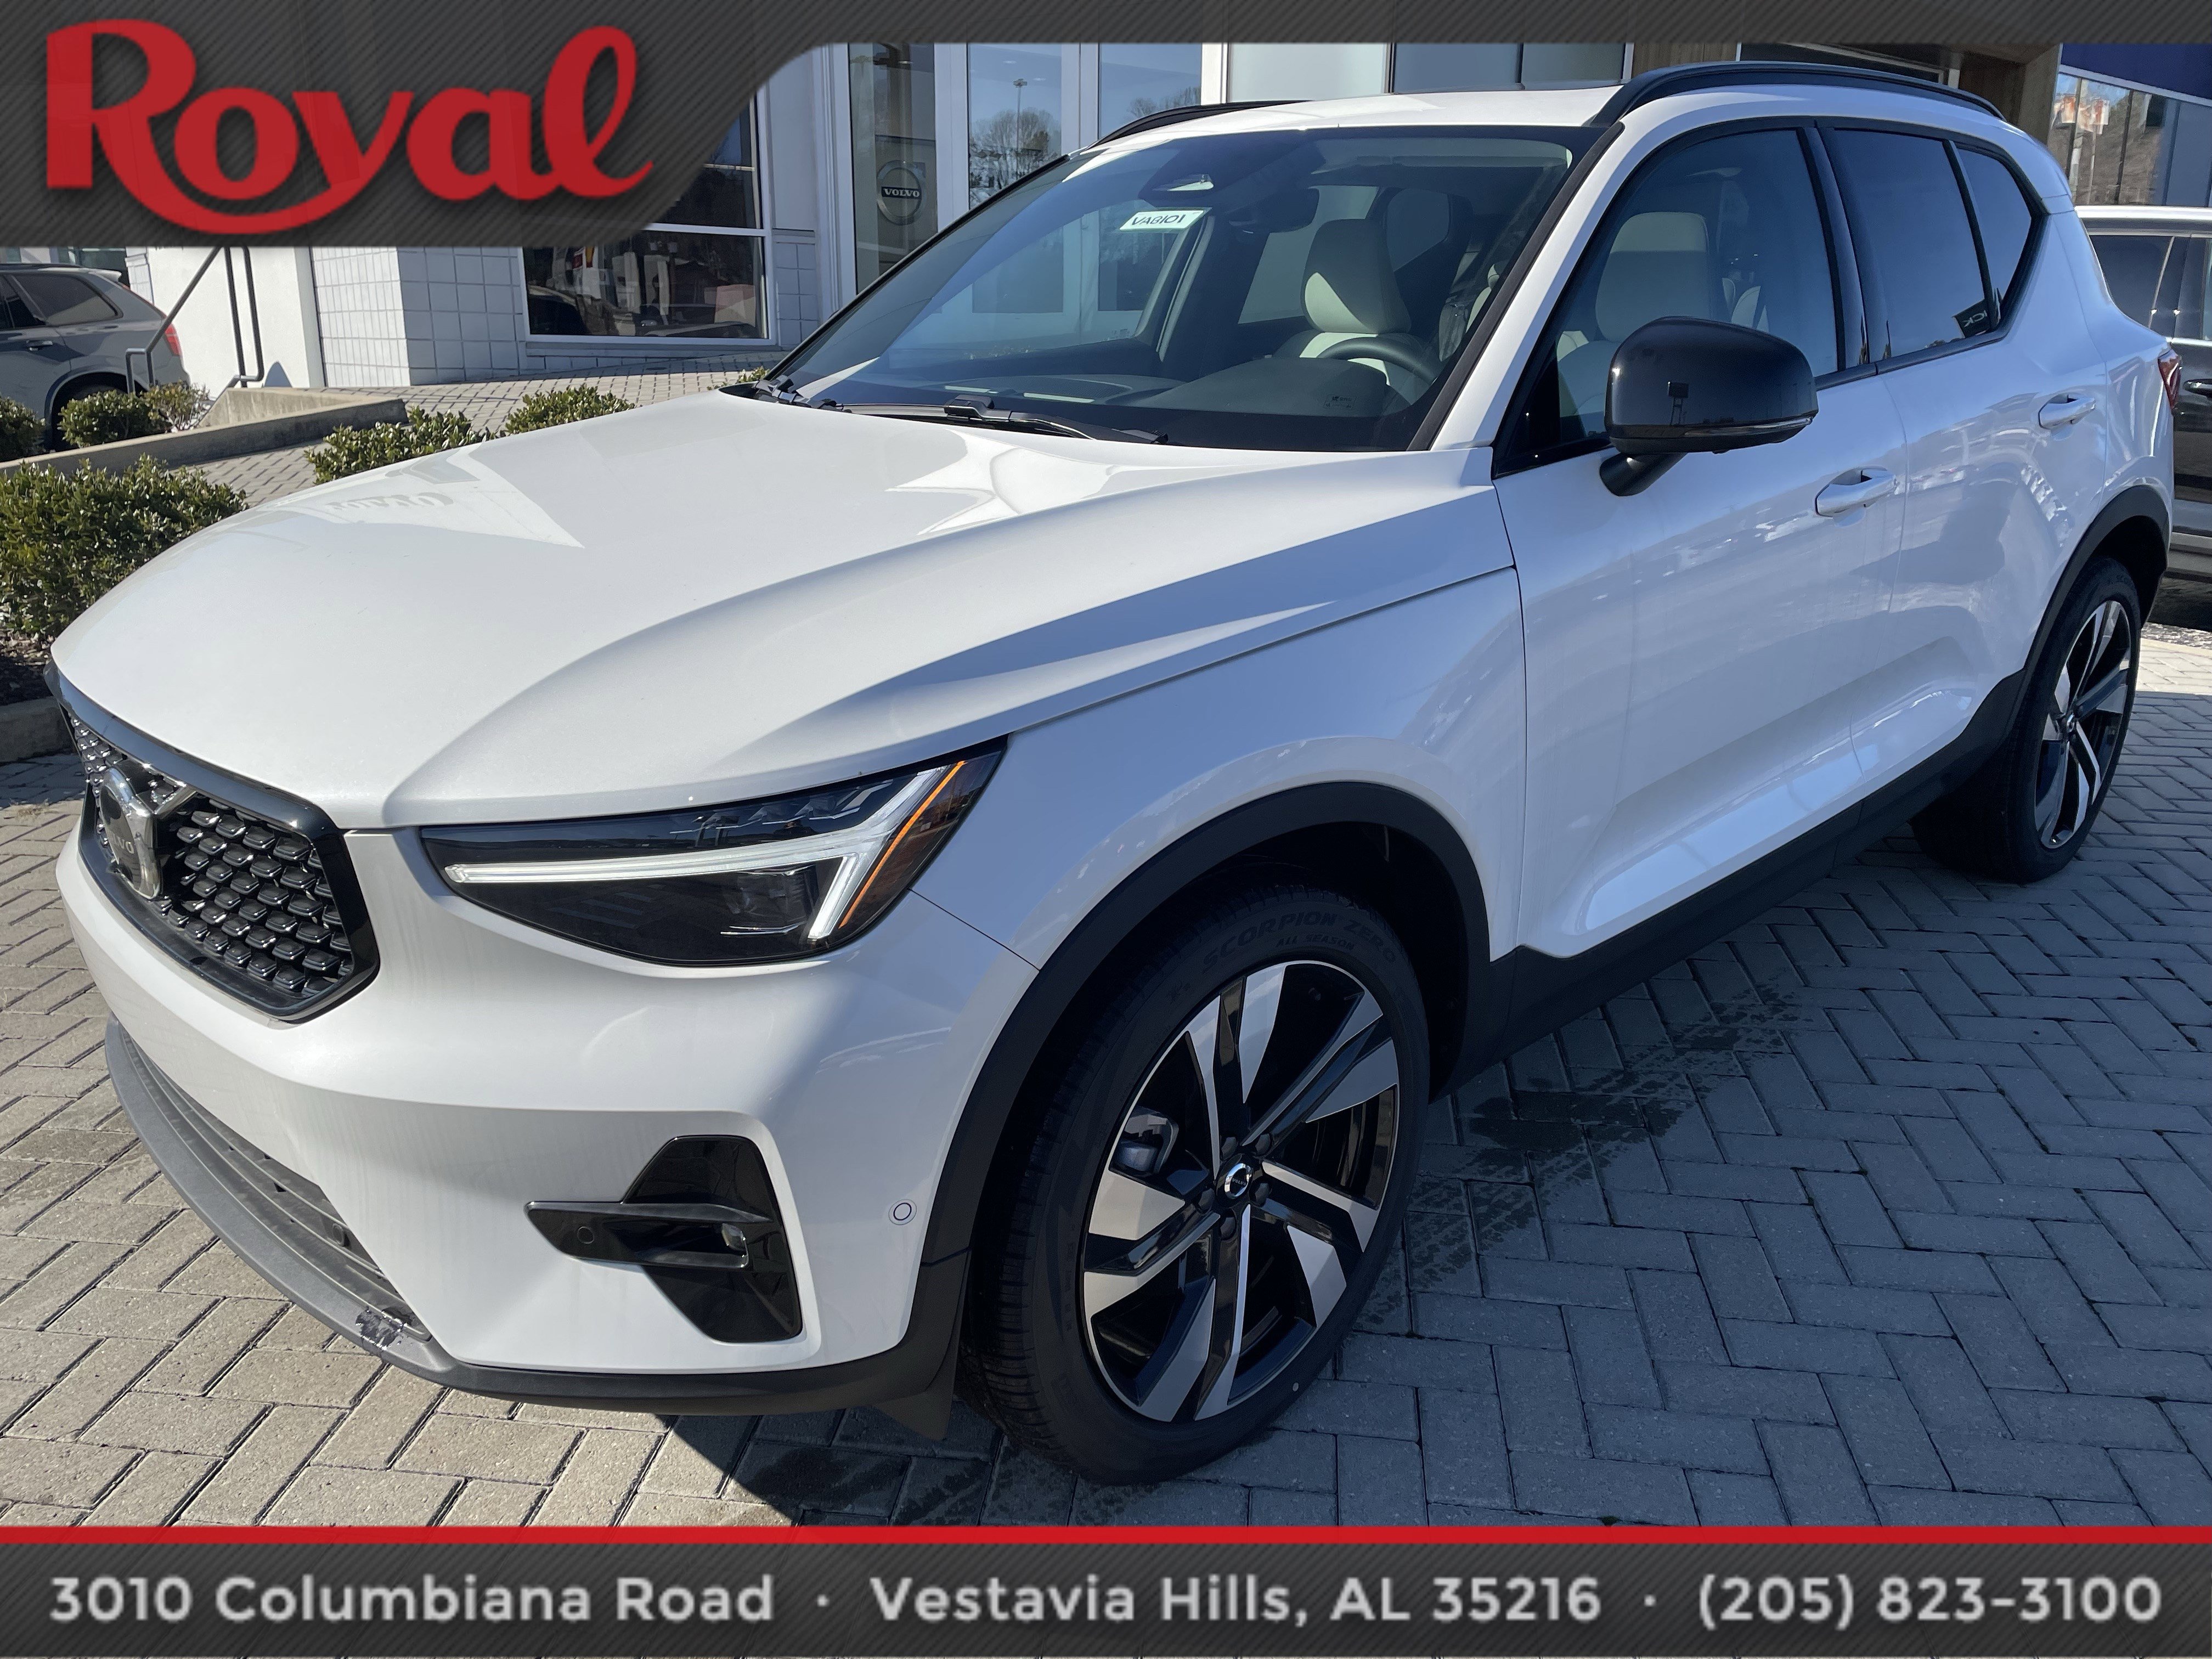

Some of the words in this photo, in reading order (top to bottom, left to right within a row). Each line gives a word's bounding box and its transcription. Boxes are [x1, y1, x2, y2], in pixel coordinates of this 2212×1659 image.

[883, 188, 920, 198] VOLVO
[1203, 911, 1339, 973] SCORPION
[1342, 918, 1397, 964] ZERO
[1275, 935, 1299, 948] ALL
[1305, 934, 1356, 952] SEASON
